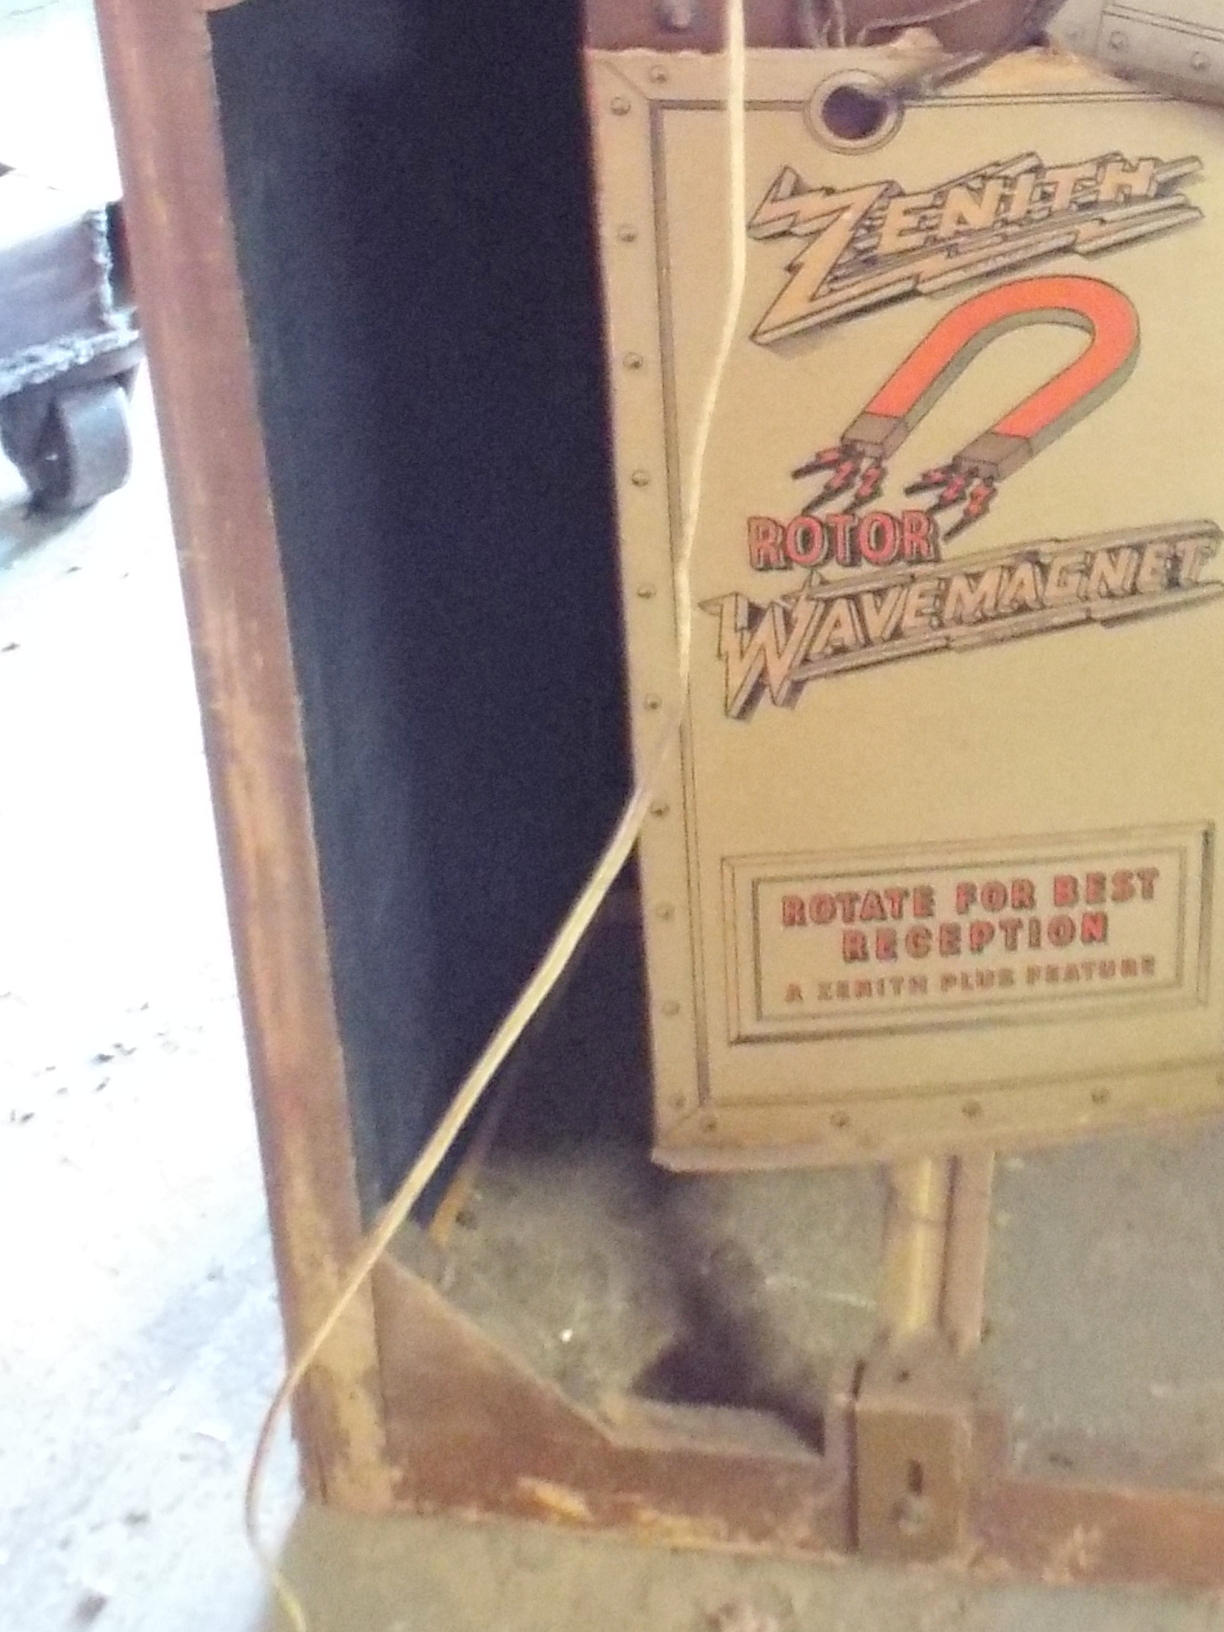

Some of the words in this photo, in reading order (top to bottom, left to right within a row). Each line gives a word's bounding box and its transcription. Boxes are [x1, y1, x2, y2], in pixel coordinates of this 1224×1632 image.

[747, 152, 1195, 345] ZENITH
[747, 509, 941, 569] ROTOR
[702, 526, 1224, 720] WAVEMAGNET
[782, 885, 934, 927] ROTATE
[956, 879, 1036, 915] FOR
[1053, 868, 1161, 908] BEST
[842, 911, 1109, 963] RECEPTION
[785, 984, 804, 1002] A
[817, 974, 930, 1002] ZENITH
[940, 968, 1016, 993] PLUS
[1026, 955, 1157, 987] FEATURE
